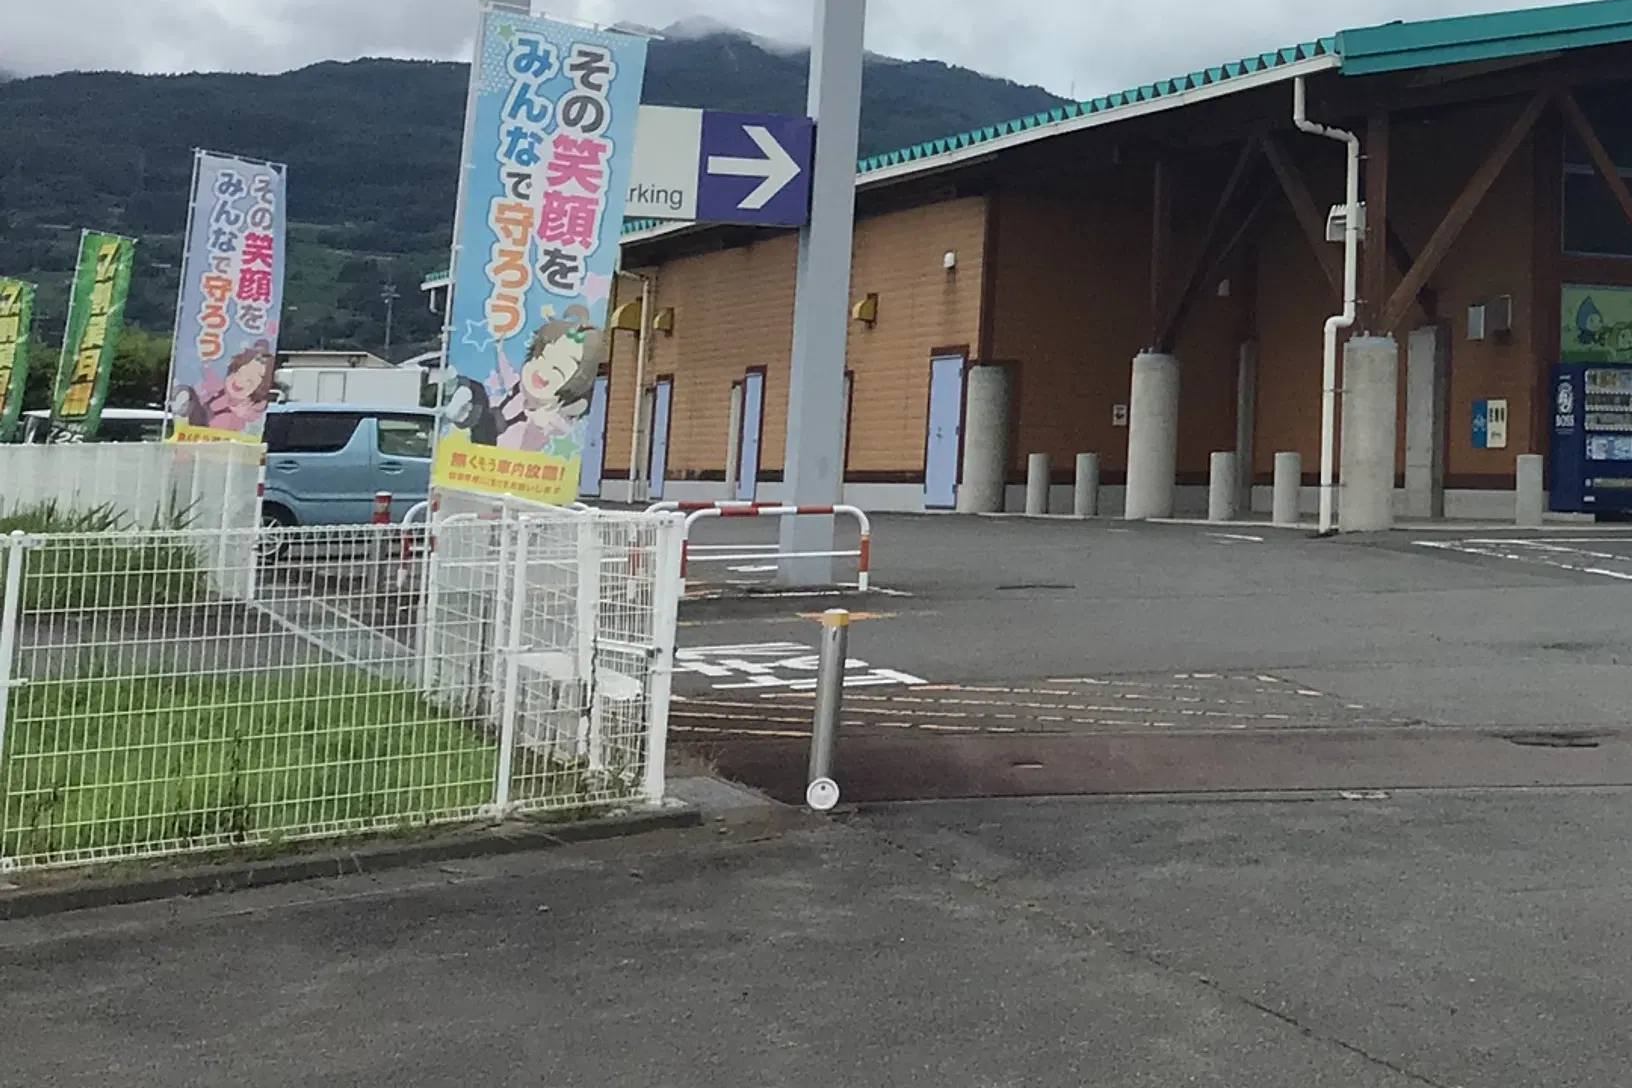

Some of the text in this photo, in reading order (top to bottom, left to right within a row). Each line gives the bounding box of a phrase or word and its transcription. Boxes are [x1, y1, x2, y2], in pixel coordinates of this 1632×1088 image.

[235, 174, 275, 330] その笑顔を
[490, 36, 554, 334] みんなで守ろう
[535, 47, 611, 292] その笑顔を
[624, 183, 683, 210] rking
[200, 171, 244, 359] みんなで守ろう
[1555, 414, 1575, 427] BOSS
